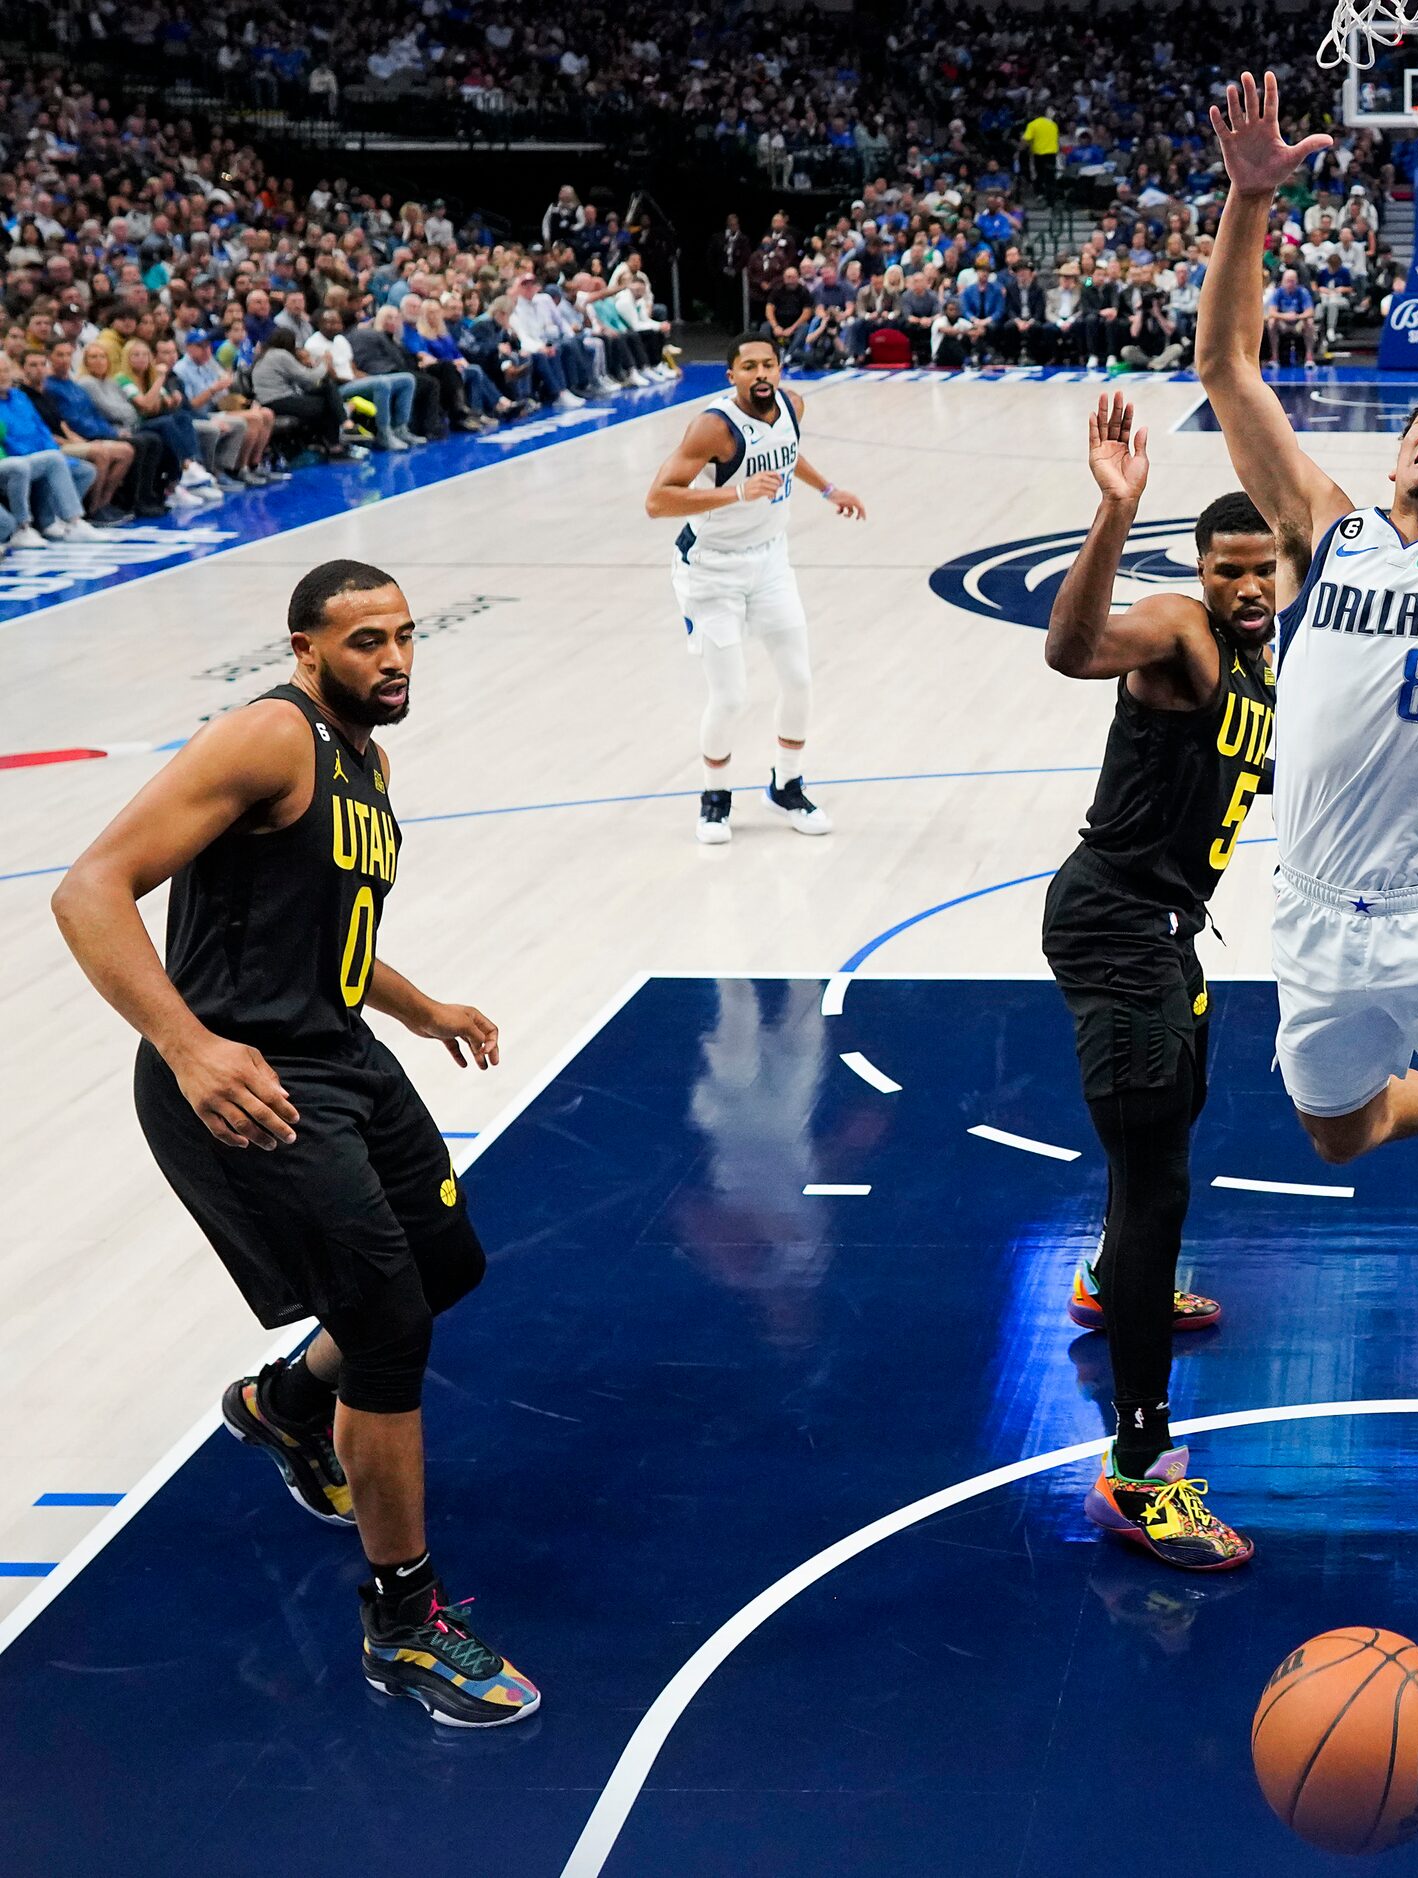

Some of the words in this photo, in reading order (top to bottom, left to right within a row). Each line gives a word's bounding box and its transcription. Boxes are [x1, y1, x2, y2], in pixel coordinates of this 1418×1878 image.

[745, 441, 797, 477] DALLAS
[1347, 518, 1360, 538] 6
[316, 722, 331, 742] 6
[1216, 691, 1276, 769] UTA
[332, 795, 396, 884] UTAH
[1208, 771, 1261, 870] 5
[340, 886, 374, 1007] 0
